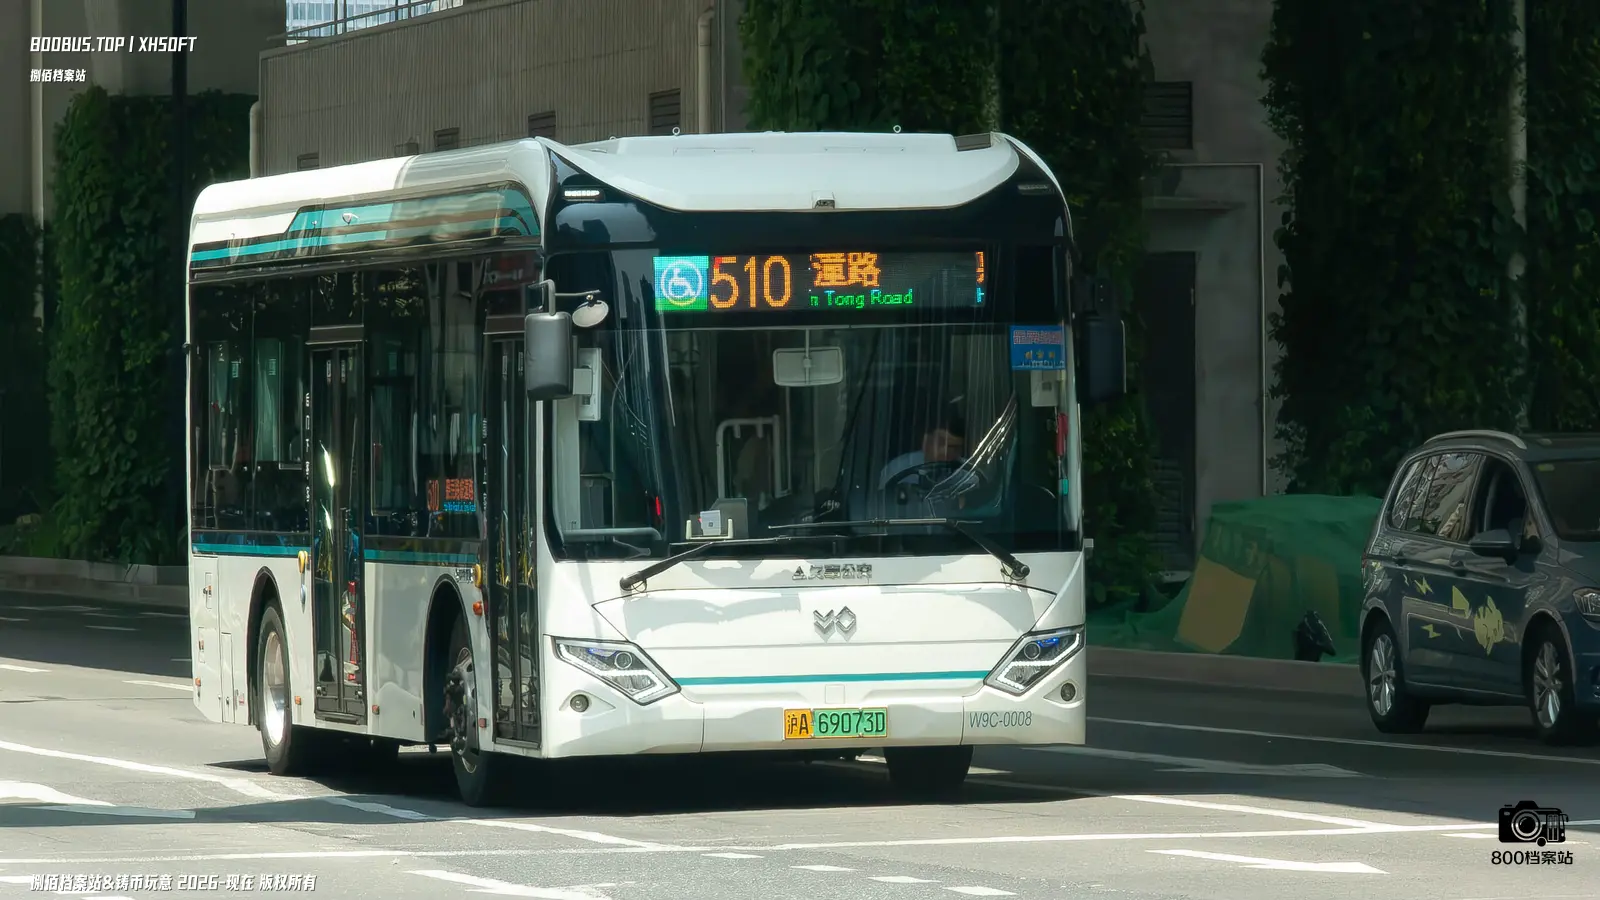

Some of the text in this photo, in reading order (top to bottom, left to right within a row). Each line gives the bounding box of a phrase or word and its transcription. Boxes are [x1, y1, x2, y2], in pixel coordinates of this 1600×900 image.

[710, 255, 791, 308] 510
[824, 290, 865, 309] Tong
[870, 288, 913, 304] Road
[808, 563, 873, 580] 久事公交
[818, 711, 886, 734] 69073D
[969, 710, 1032, 728] W9C-0008
